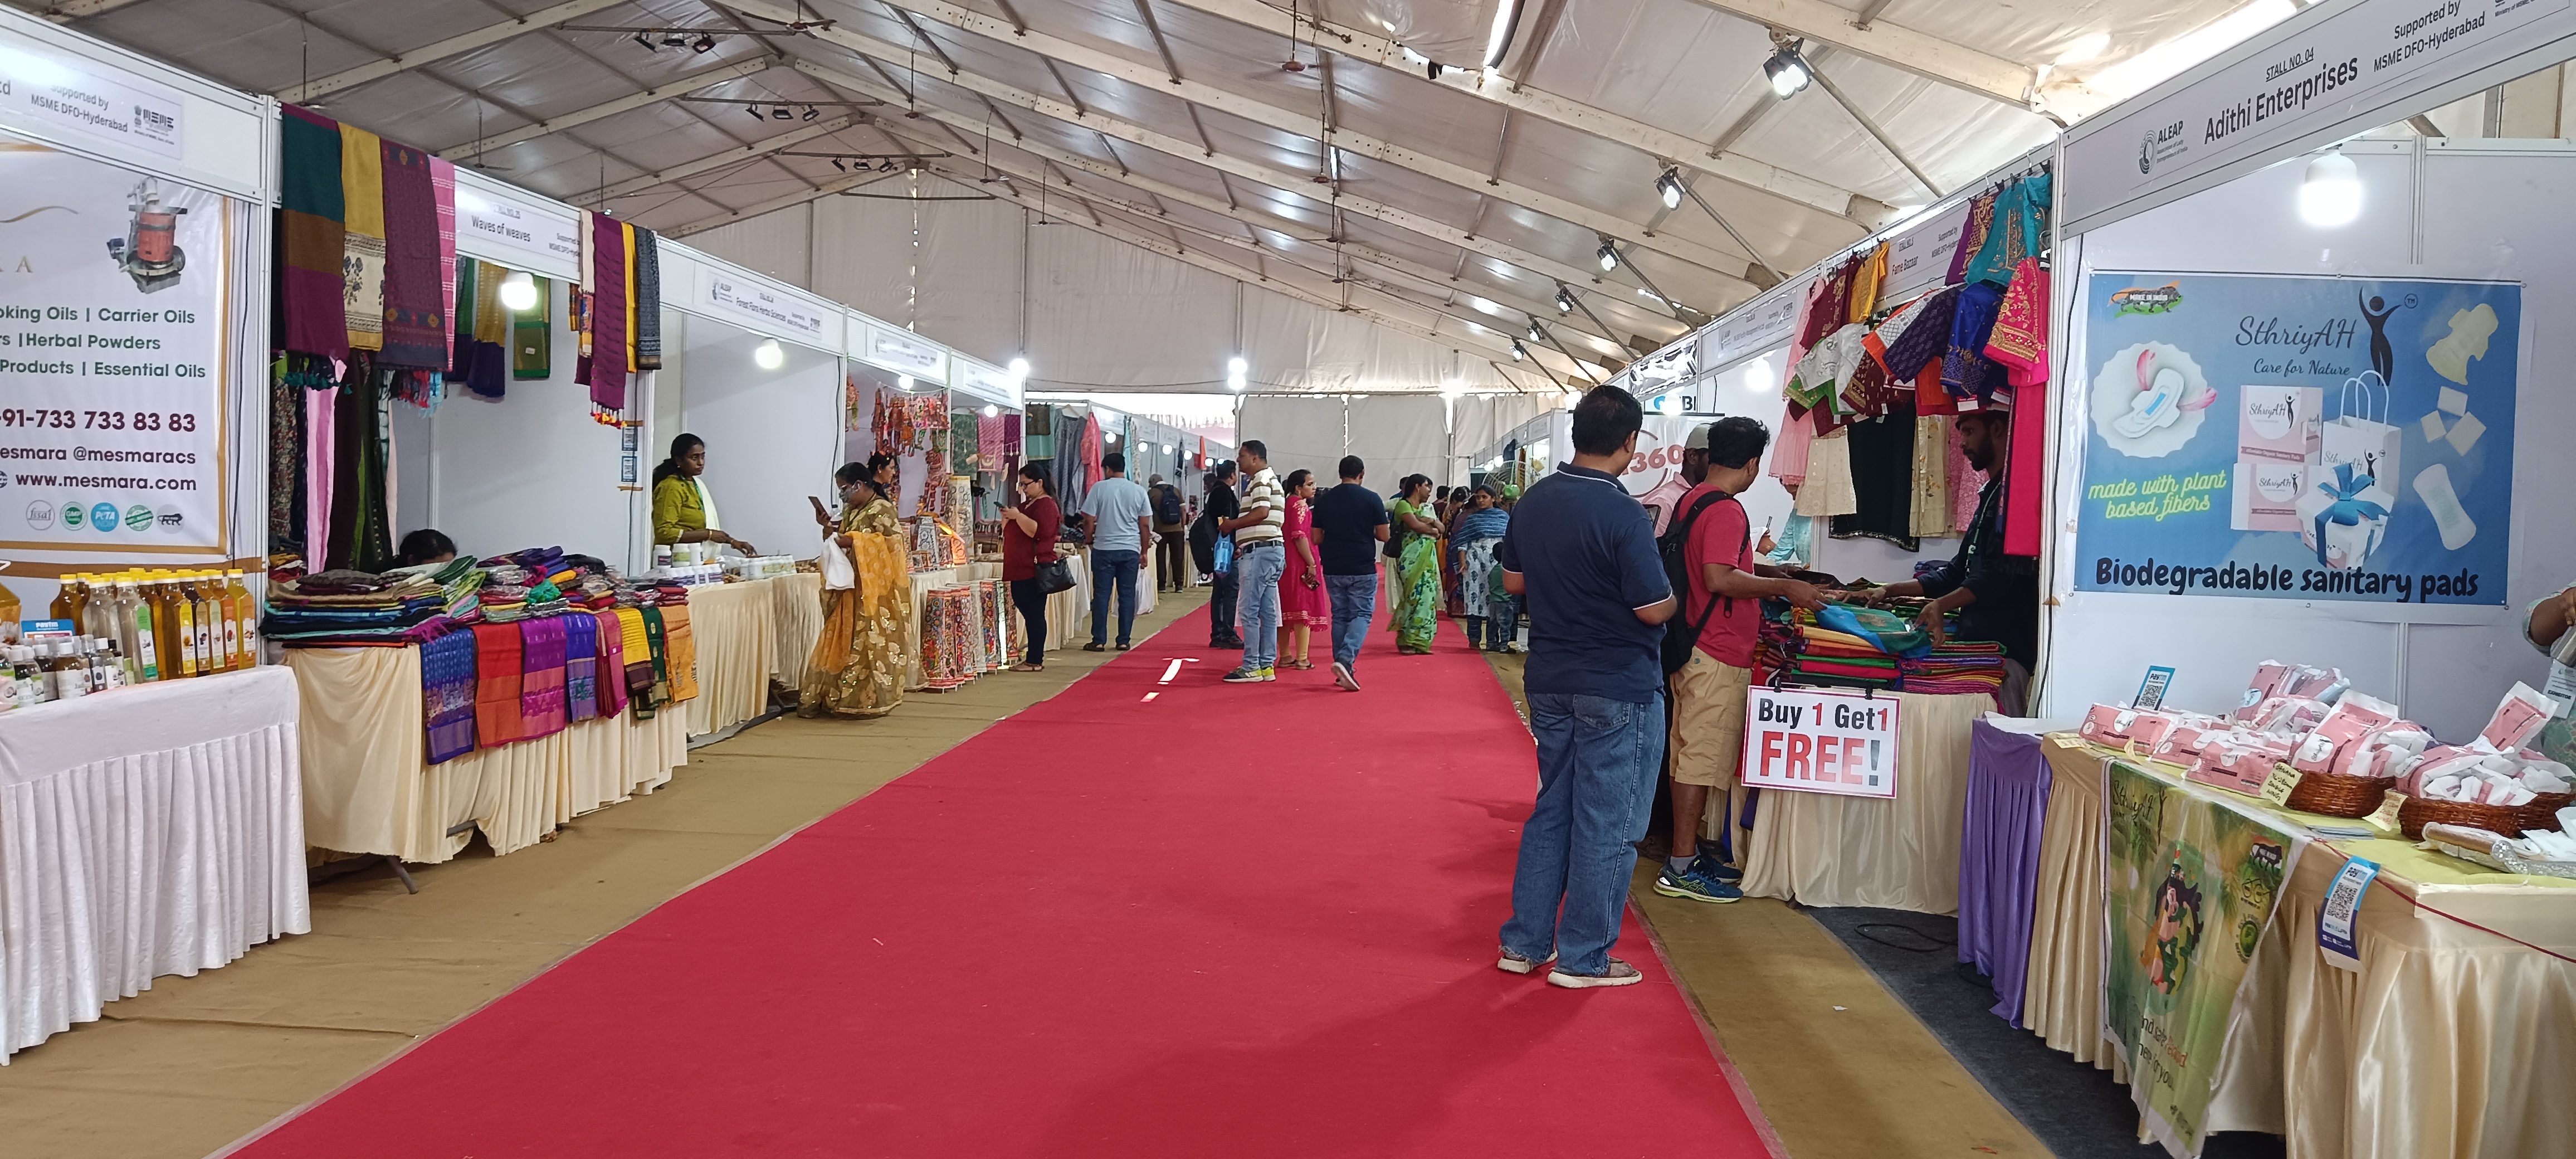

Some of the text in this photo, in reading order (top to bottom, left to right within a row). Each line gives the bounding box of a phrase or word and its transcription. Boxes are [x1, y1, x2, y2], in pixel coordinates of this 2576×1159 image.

[2394, 0, 2461, 40] Supported by
[2374, 11, 2485, 72] MSME DFO-Hyderabad
[2266, 46, 2315, 81] STALL NO. 04
[31, 94, 128, 133] MSME DFO-Hyderabad
[98, 96, 109, 111] by
[2204, 57, 2358, 145] Adithi Enterprises
[2158, 120, 2183, 145] ALEAP
[471, 215, 531, 242] Waves of weaves
[47, 306, 78, 320] Oils
[98, 308, 159, 323] Carrier
[164, 309, 195, 324] Oils
[88, 334, 161, 350] Powders
[2236, 315, 2357, 355] SthriyAH
[0, 359, 75, 374] Products
[94, 361, 169, 377] Essential
[174, 363, 206, 378] Oils
[2254, 358, 2350, 378] Care for Nature
[84, 410, 125, 430] 733
[133, 412, 161, 431] 83
[168, 413, 196, 432] 83
[2249, 402, 2287, 418] SthriyAH
[73, 446, 196, 464] @mesmaracs
[16, 473, 197, 491] www.mesmara.com
[2088, 470, 2227, 500] made with plant
[2259, 478, 2292, 489] SthriyAH
[2105, 492, 2211, 522] based fibers
[2096, 557, 2479, 603] Biodegradable sanitary pads
[1758, 698, 1803, 729] Buy
[1812, 703, 1823, 726] 1
[1760, 731, 1880, 786] FREE!
